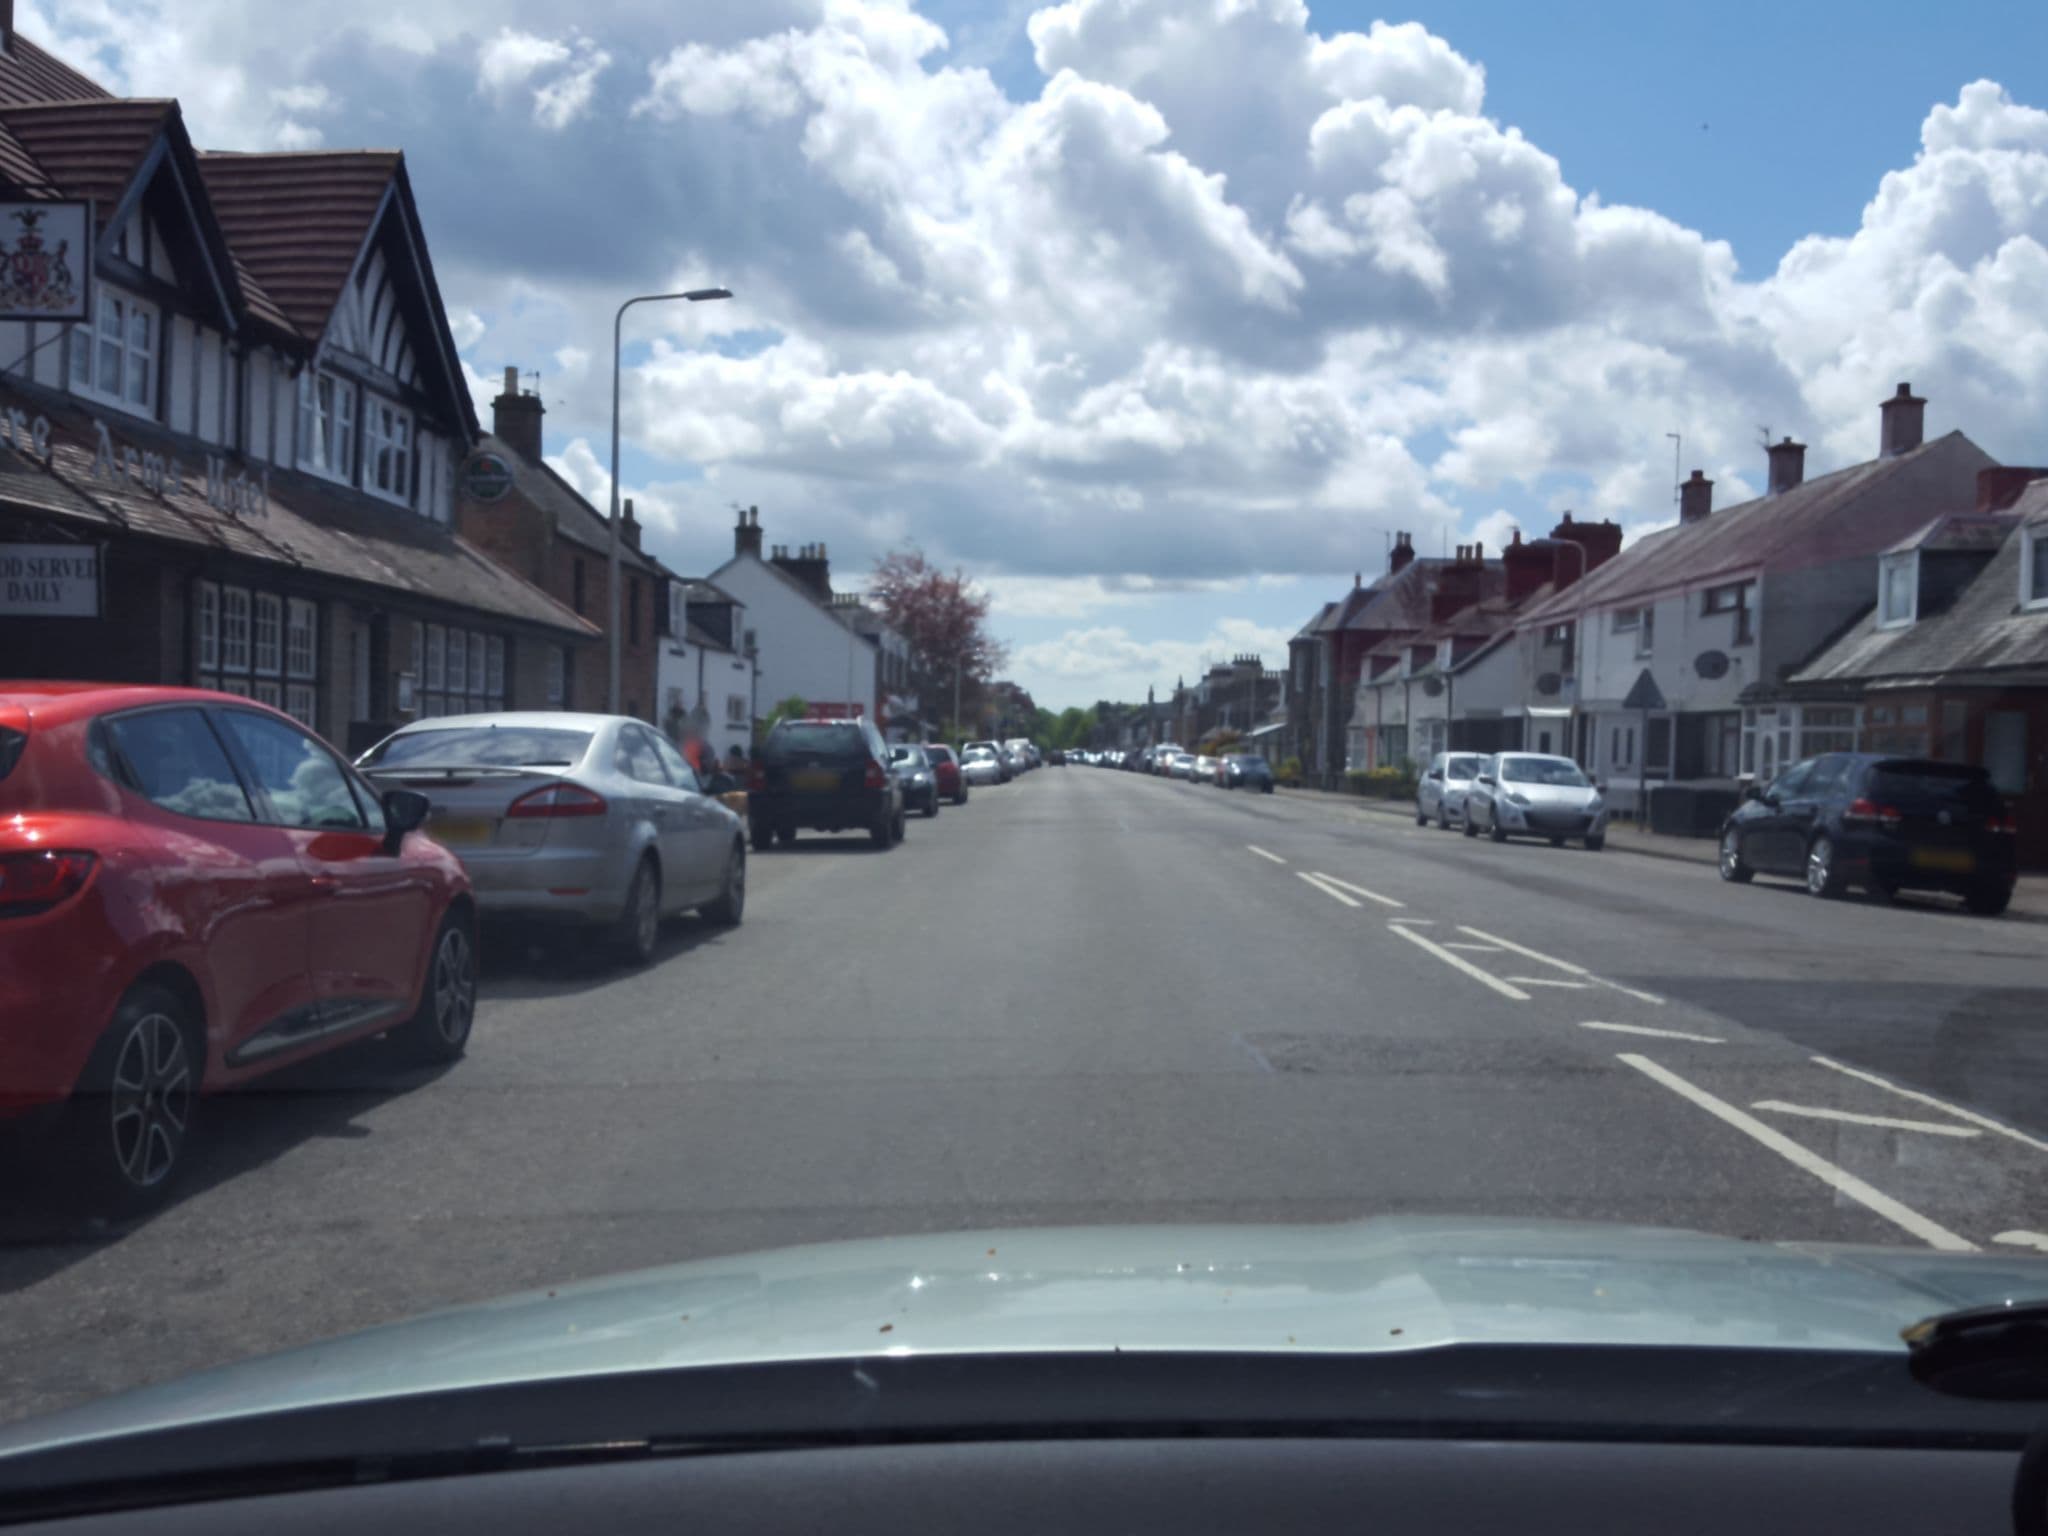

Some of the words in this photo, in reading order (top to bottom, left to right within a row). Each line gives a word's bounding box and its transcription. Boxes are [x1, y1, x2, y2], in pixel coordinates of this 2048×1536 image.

[92, 418, 183, 496] Arms
[206, 452, 269, 518] Hotel
[7, 581, 64, 603] DAILY
